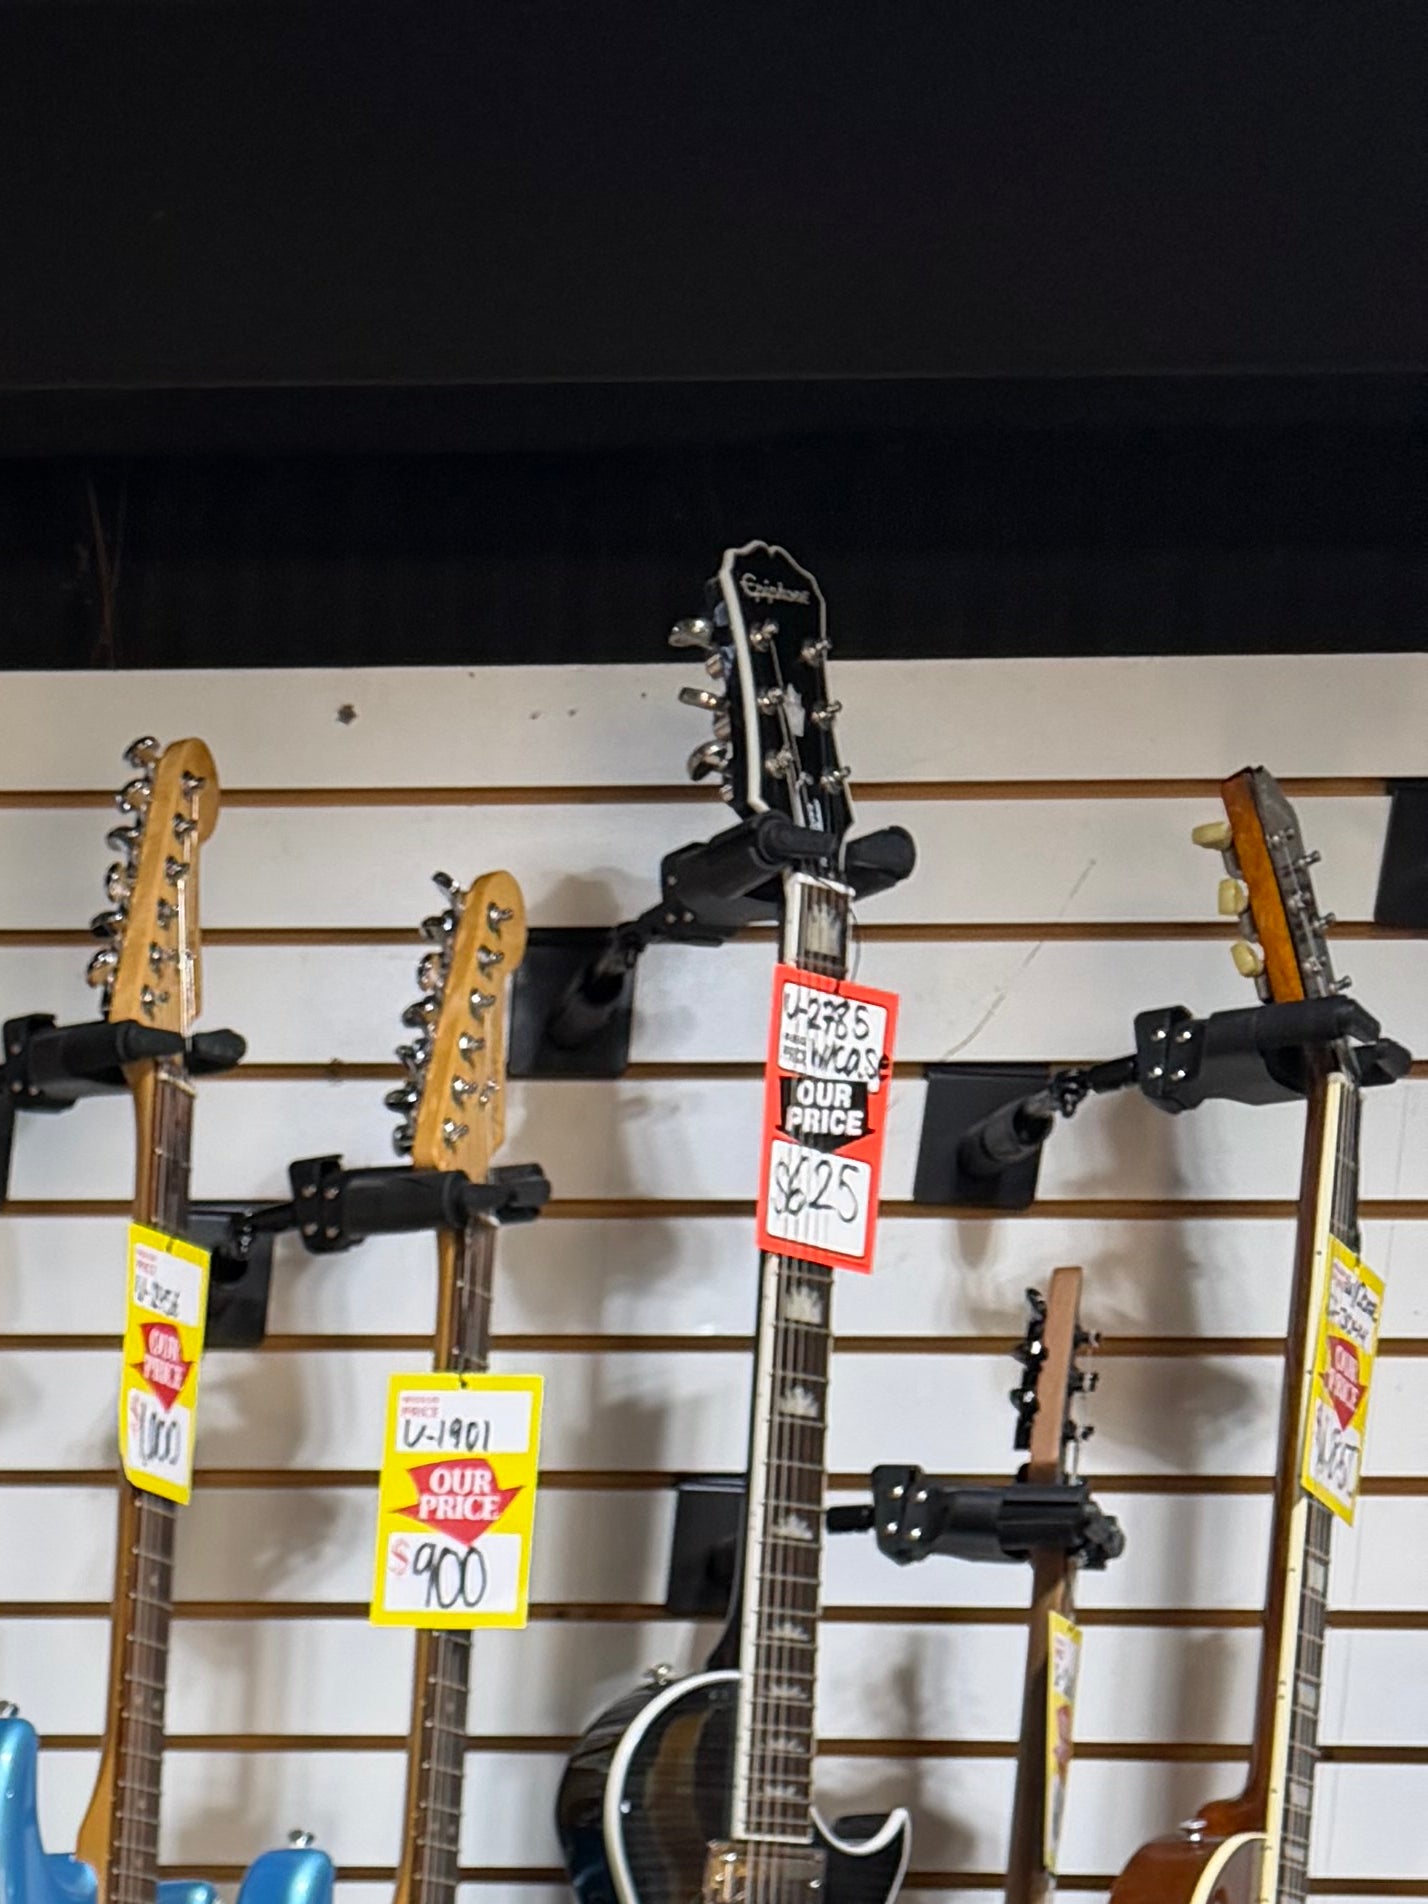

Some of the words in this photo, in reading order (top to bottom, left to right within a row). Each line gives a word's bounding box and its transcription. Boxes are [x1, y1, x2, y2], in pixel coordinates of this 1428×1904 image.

[795, 1080, 853, 1107] OUR
[785, 1105, 864, 1137] PRICE
[428, 1466, 493, 1495] OUR
[417, 1494, 502, 1521] PRICE
[390, 1538, 488, 1609] $900
